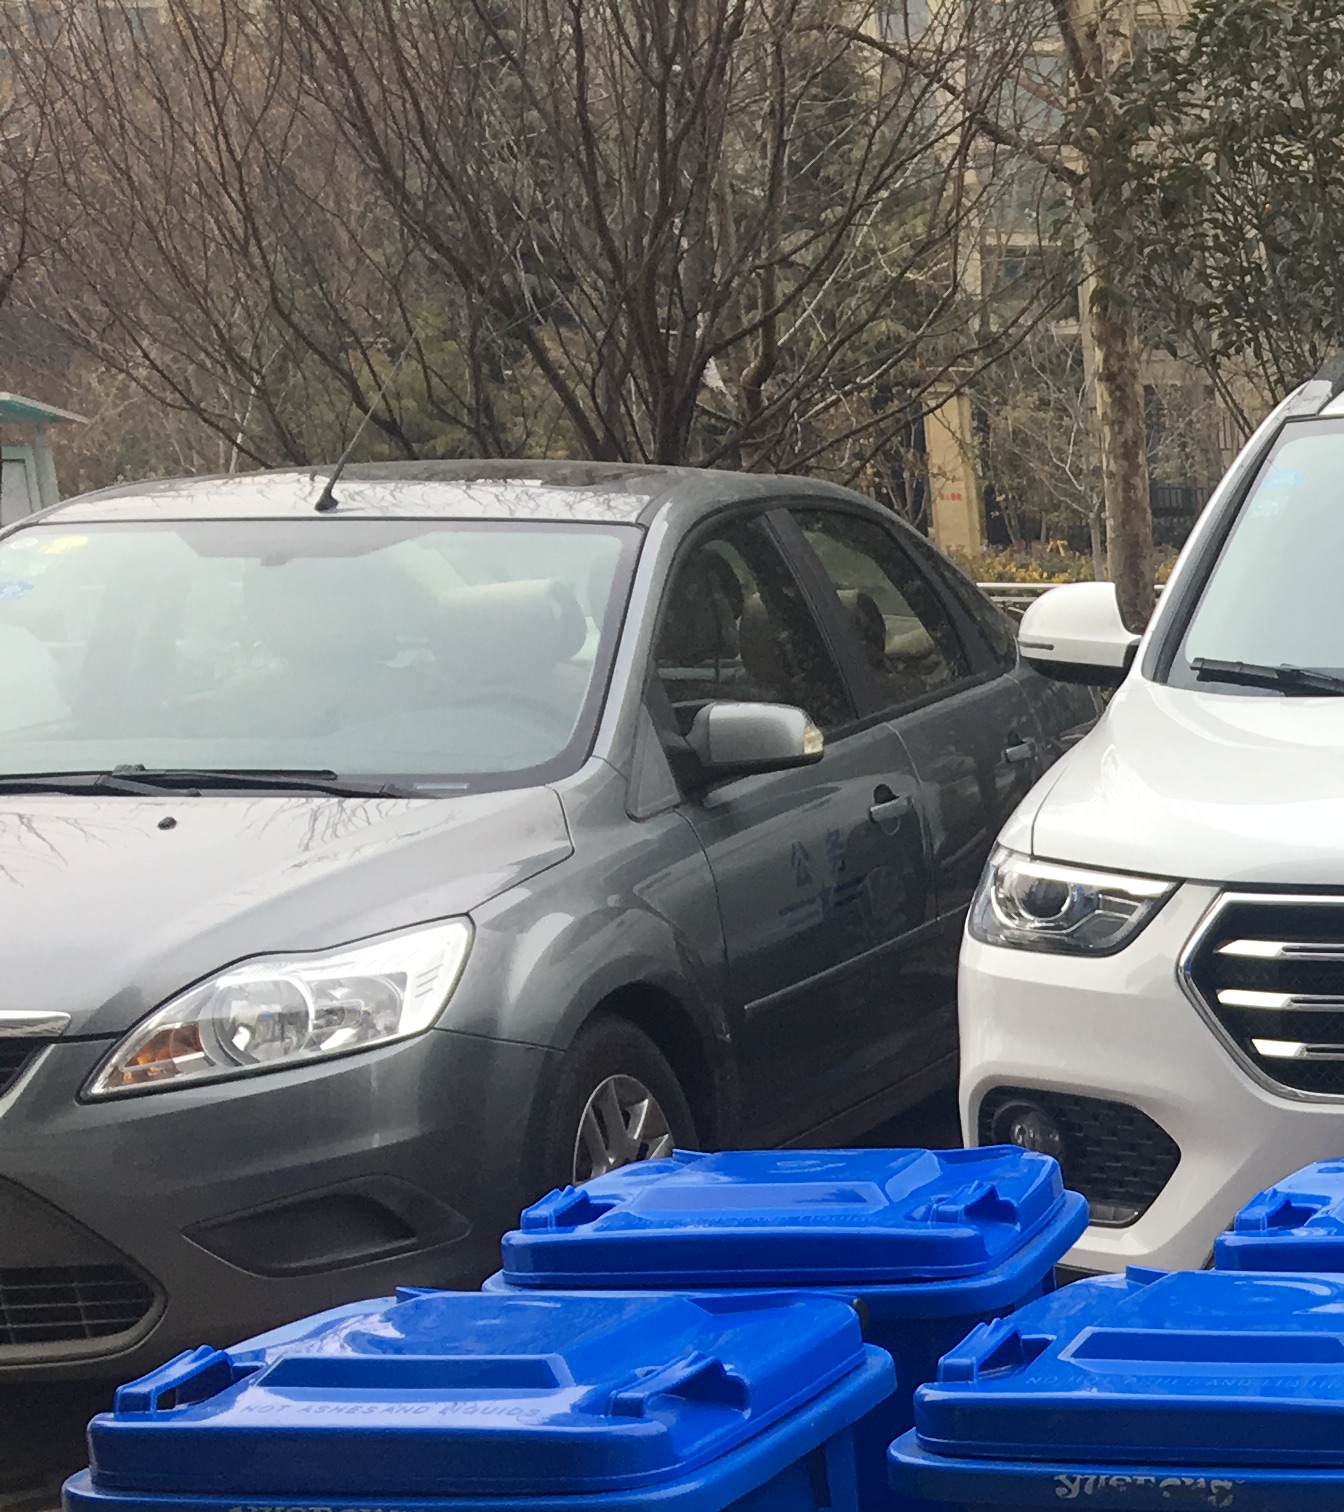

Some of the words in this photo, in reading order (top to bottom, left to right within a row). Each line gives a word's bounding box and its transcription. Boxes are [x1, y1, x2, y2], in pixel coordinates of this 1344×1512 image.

[240, 1404, 291, 1414] HOT
[295, 1405, 379, 1415] ASHES
[379, 1405, 429, 1415] AND
